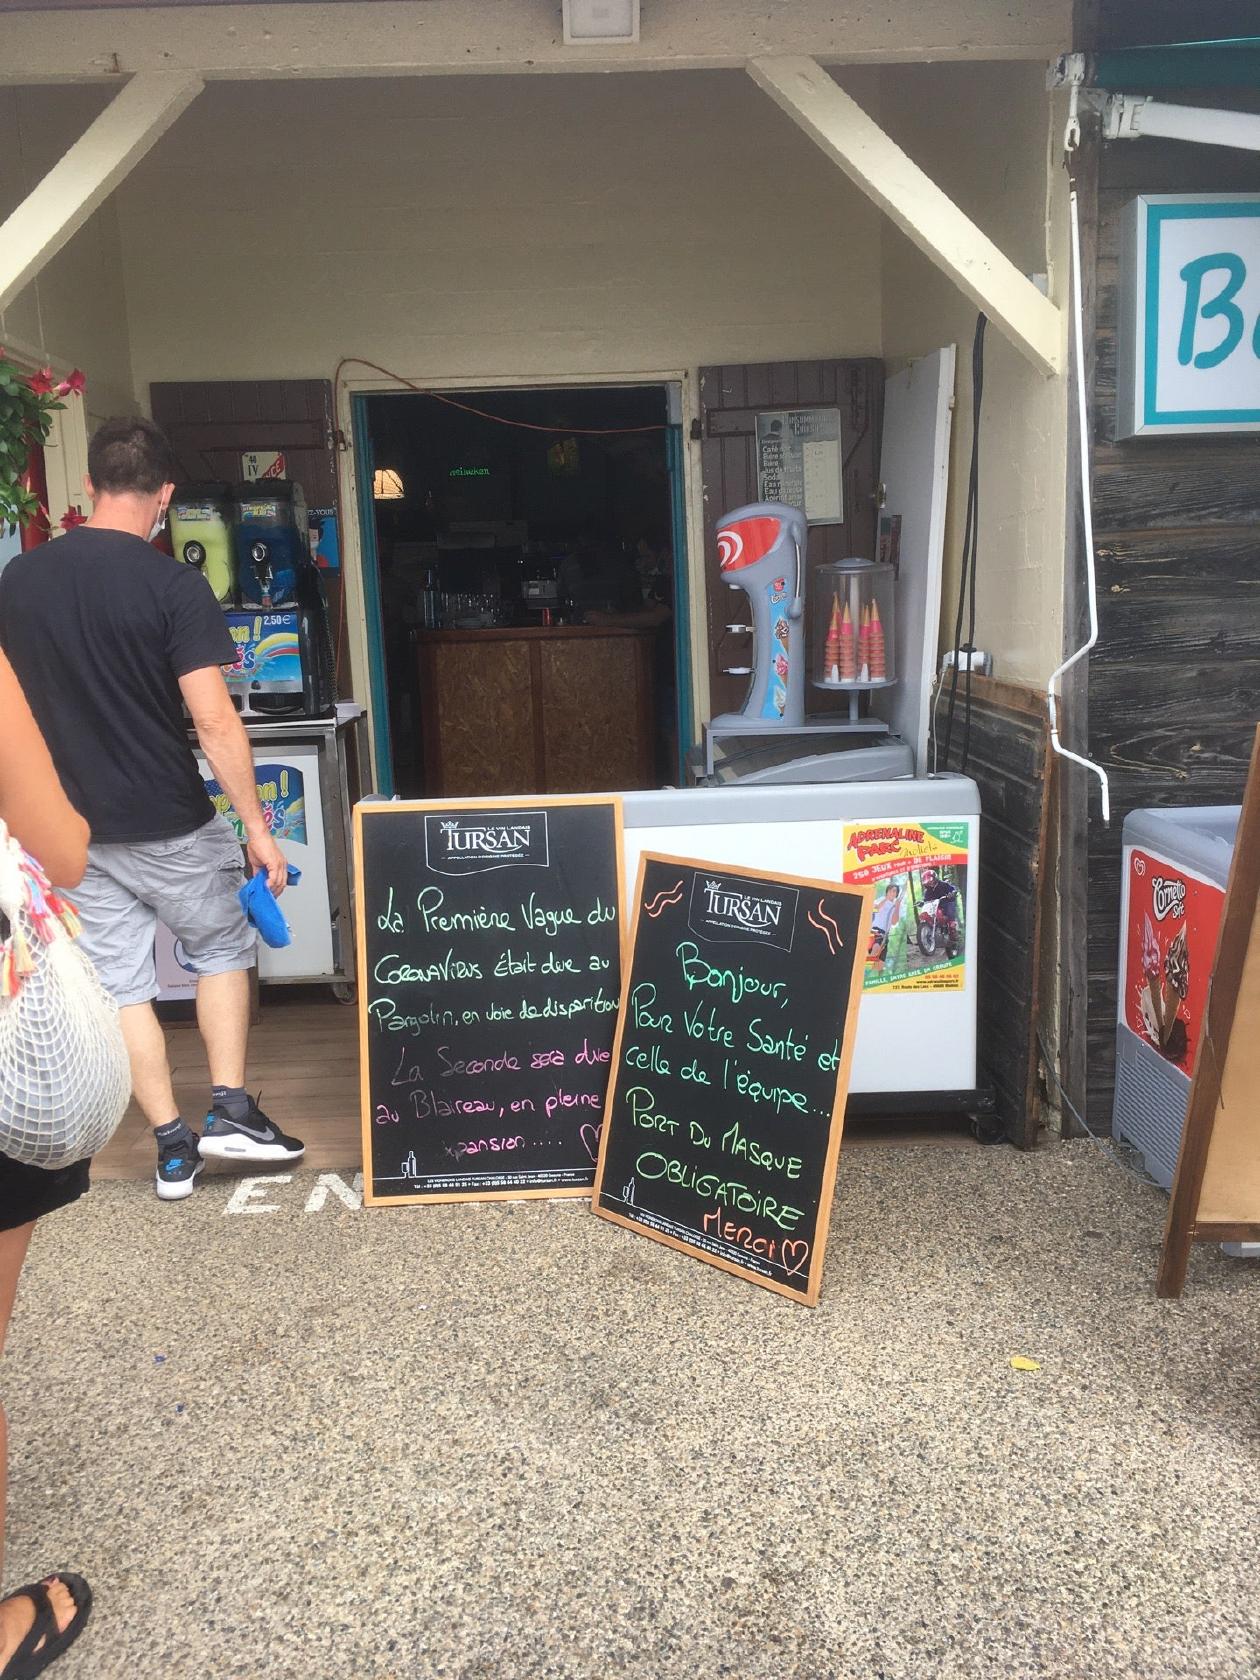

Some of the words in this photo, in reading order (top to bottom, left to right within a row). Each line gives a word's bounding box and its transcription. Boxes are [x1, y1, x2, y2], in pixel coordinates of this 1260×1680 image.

[1178, 252, 1260, 369] B
[440, 826, 531, 853] TURSAN
[378, 886, 404, 933] La
[522, 892, 582, 936] Vague
[587, 898, 616, 924] du
[704, 887, 782, 928] TURSAN
[1152, 877, 1186, 921] Cornetto
[588, 956, 610, 971] au
[676, 942, 789, 1009] Bonjour,
[462, 1011, 480, 1025] en
[391, 1047, 424, 1086] La
[680, 1058, 711, 1085] de
[818, 1039, 841, 1071] et
[510, 1098, 536, 1112] en
[545, 1088, 602, 1118] pleine
[722, 1121, 802, 1180] MASQUE
